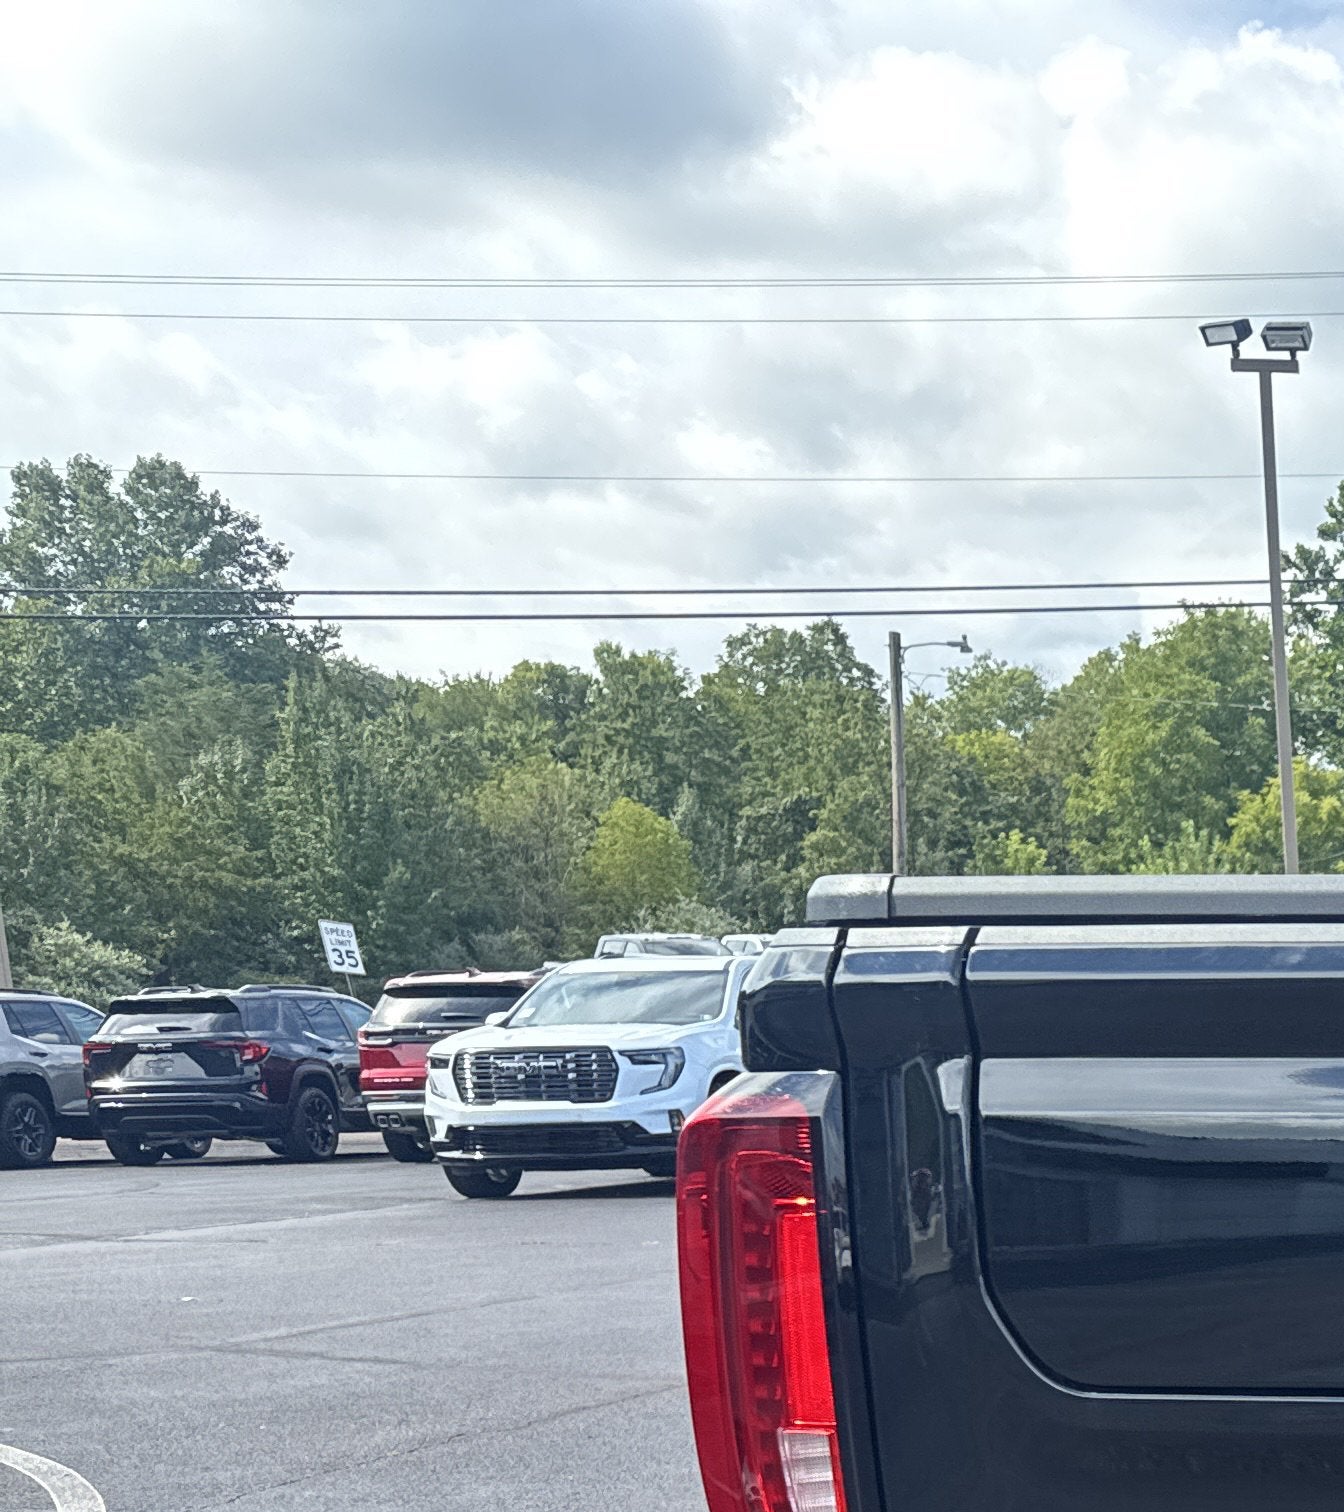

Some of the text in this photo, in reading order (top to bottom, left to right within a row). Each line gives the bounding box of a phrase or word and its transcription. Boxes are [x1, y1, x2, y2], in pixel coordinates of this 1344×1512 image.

[323, 927, 353, 938] SPEED
[329, 938, 352, 947] LIMIT
[331, 948, 359, 968] 35
